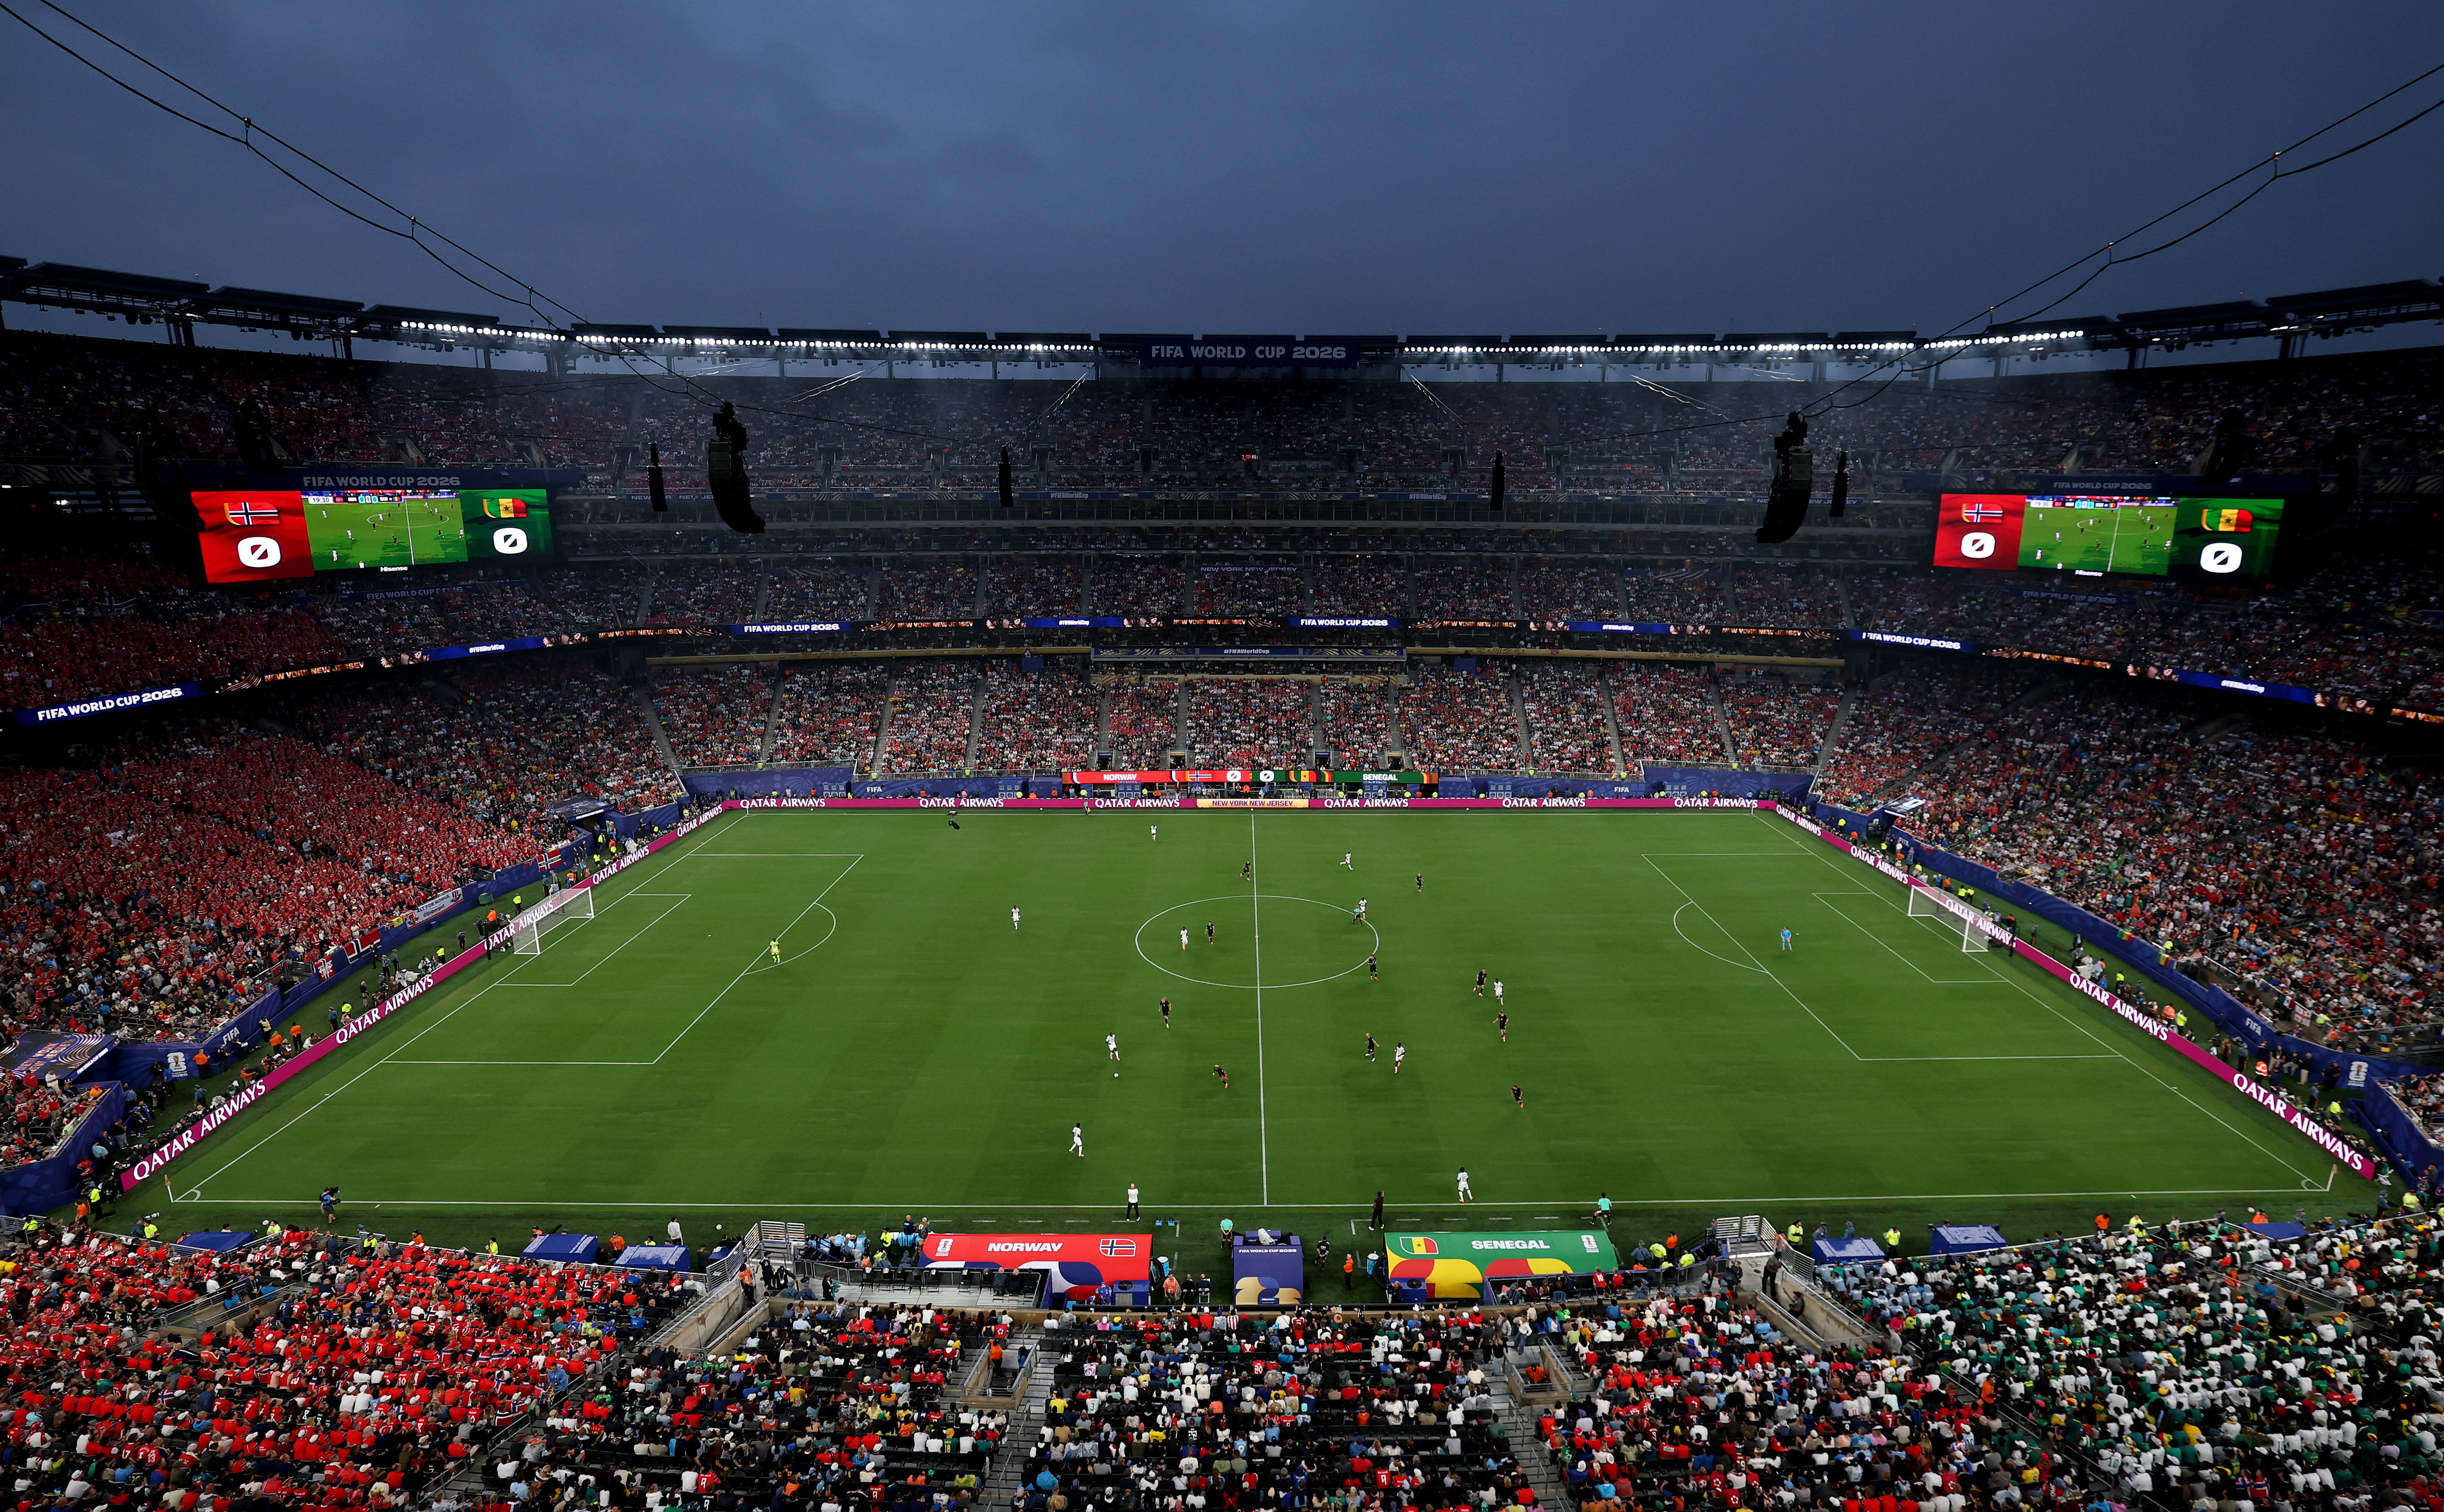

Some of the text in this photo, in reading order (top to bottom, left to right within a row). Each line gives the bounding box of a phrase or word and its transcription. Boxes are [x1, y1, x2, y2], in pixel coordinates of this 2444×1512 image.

[1152, 346, 1346, 358] FIFA WORLD CUP 2026
[303, 476, 460, 486] FIFA WORLD CUP 2026
[493, 527, 528, 555] 0
[1961, 532, 1995, 558] 0
[238, 536, 281, 567] 0
[2200, 543, 2242, 573] 0
[1882, 635, 1912, 644] WORLD
[1930, 640, 1961, 649] 2026
[469, 644, 505, 653] #FIFAWorldCup
[265, 672, 284, 682] NEW
[286, 670, 309, 678] YORK
[310, 666, 330, 675] NEW
[38, 688, 182, 720] FIFA WORLD CUP 2026
[740, 799, 826, 809] QATAR AIRWAYS
[919, 799, 1004, 808] QATAR AIRWAYS
[1095, 799, 1180, 808] QATAR AIRWAYS
[1324, 799, 1408, 808] QATAR AIRWAYS
[1502, 798, 1586, 808] QATAR AIRWAYS
[1674, 798, 1758, 808] QATAR AIRWAYS
[677, 804, 722, 837] QATAR AIRWAYS
[1776, 805, 1822, 837] QATAR AIRWAYS
[592, 845, 649, 884] QATAR AIRWAYS
[1850, 846, 1909, 885] QATAR AIRWAYS
[435, 894, 450, 905] NORGE
[519, 900, 554, 931] AIRWAYS
[1946, 899, 1974, 925] QATAR
[336, 973, 433, 1043] QATAR AIRWAYS
[2069, 973, 2168, 1041] QATAR AIRWAYS
[2245, 1017, 2261, 1036] FIFA
[223, 1026, 240, 1045] FIFA
[2233, 1074, 2363, 1170] QATAR AIRWAYS
[134, 1080, 266, 1180] QATAR AIRWAYS
[987, 1243, 1063, 1252] NORWAY
[1471, 1240, 1551, 1249] SENEGAL
[312, 1337, 317, 1346] 3
[73, 1351, 80, 1360] 3
[398, 1377, 406, 1386] 10
[302, 1409, 310, 1420] 8
[945, 1444, 951, 1453] 18
[1238, 1446, 1244, 1455] 9
[701, 1478, 707, 1489] 9
[1381, 1474, 1387, 1485] 9
[873, 1491, 878, 1499] 9
[704, 1500, 709, 1511] 9
